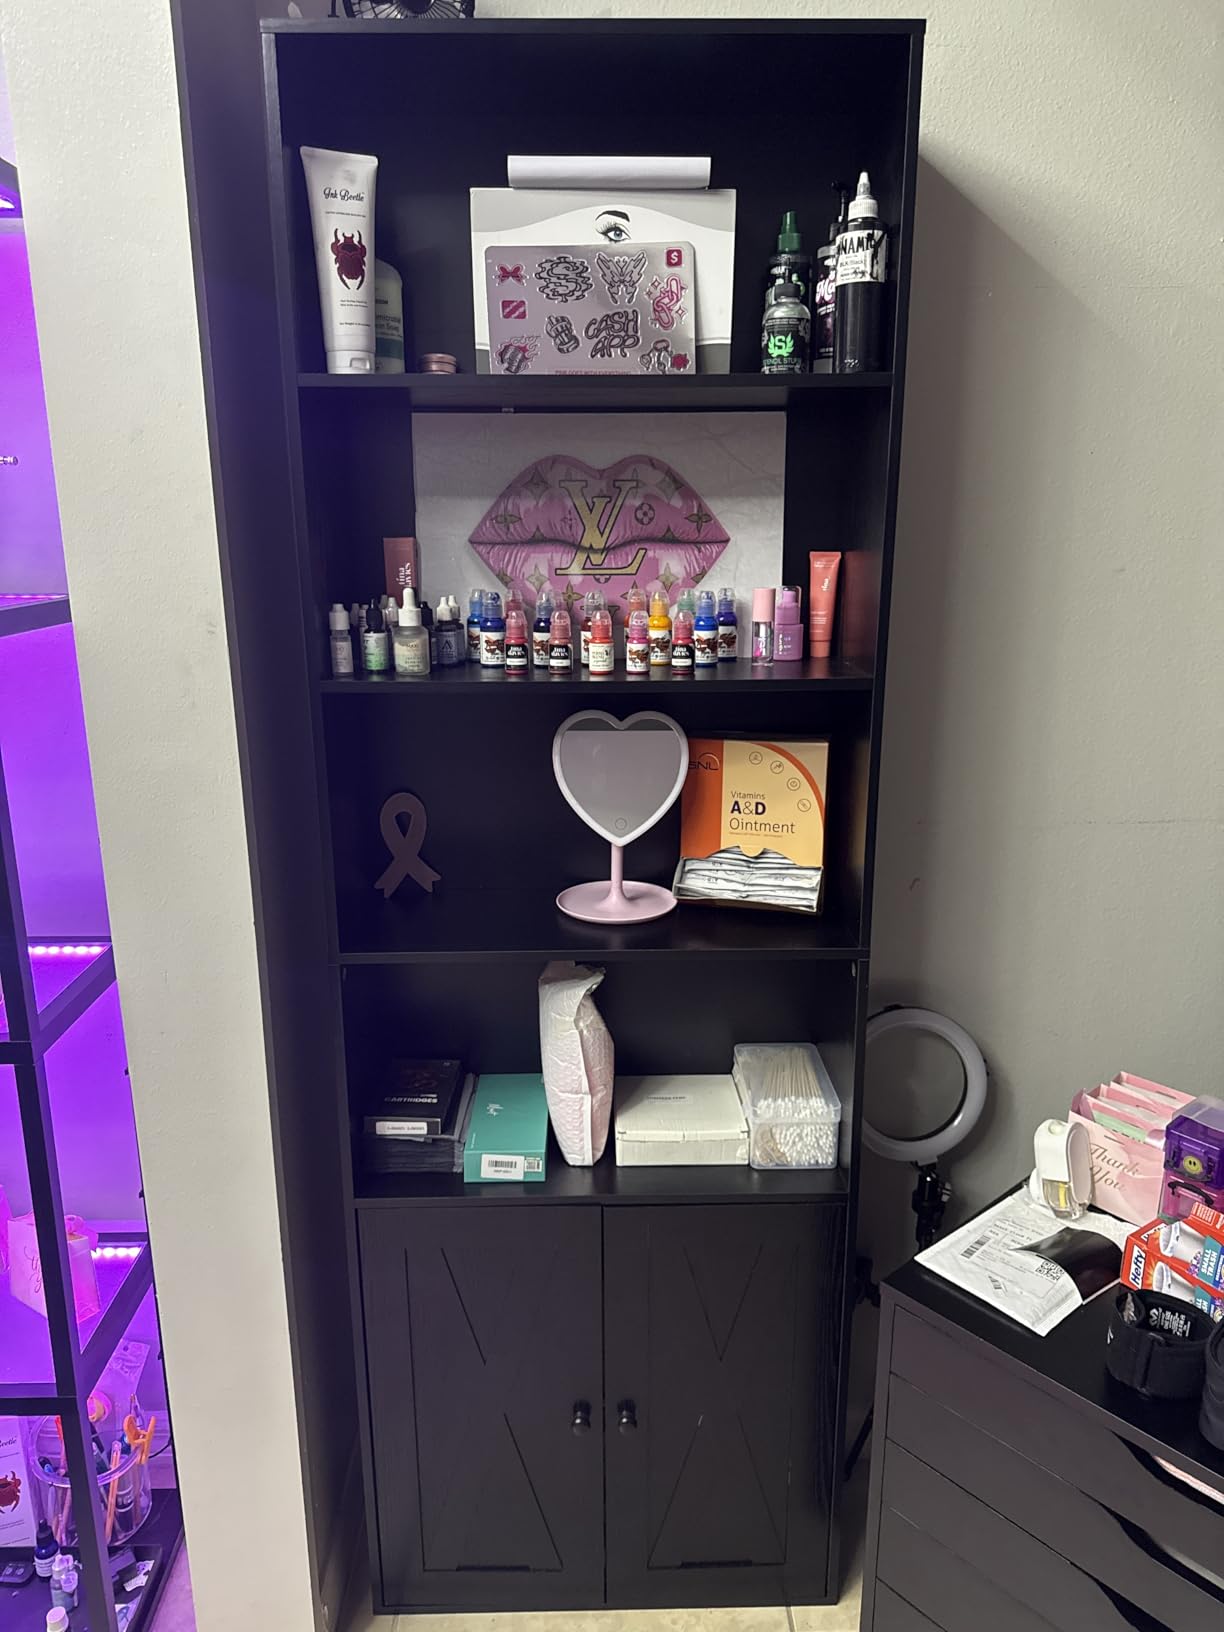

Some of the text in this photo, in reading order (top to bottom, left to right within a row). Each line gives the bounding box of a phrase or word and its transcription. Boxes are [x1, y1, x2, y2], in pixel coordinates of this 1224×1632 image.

[323, 187, 338, 199] Ink
[584, 309, 639, 340] CASH
[590, 333, 640, 359] APP
[730, 791, 766, 800] Vitamins
[730, 800, 766, 816] A&D
[729, 817, 796, 834] Ointment
[1131, 1250, 1145, 1285] Hefty
[1201, 1249, 1212, 1274] SMALL
[1206, 1251, 1218, 1277] TRASH
